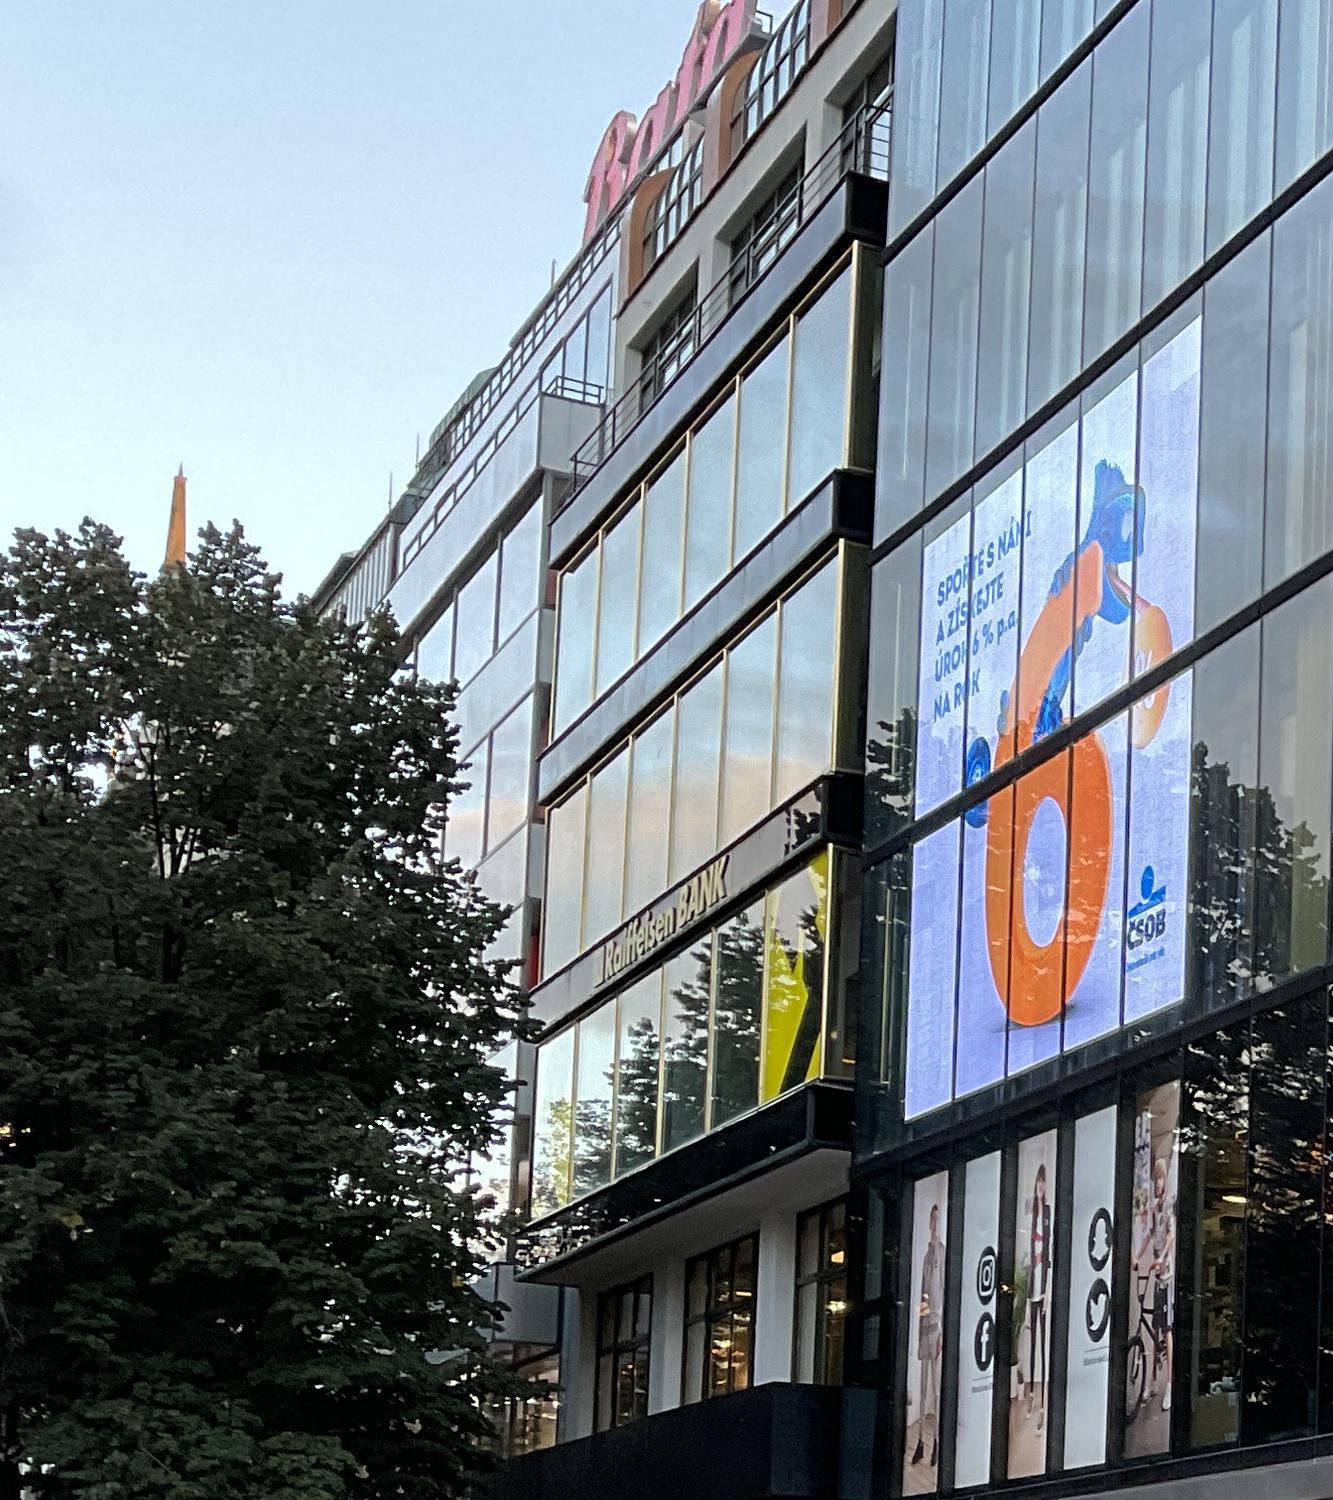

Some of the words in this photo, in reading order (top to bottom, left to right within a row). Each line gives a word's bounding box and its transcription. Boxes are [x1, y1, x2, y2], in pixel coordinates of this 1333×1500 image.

[986, 541, 995, 569] S
[935, 619, 945, 646] A
[932, 693, 951, 723] NA
[953, 668, 980, 709] RK
[603, 907, 676, 980] Raiffeisen
[678, 855, 729, 928] BANK
[1127, 908, 1166, 950] ČSOB
